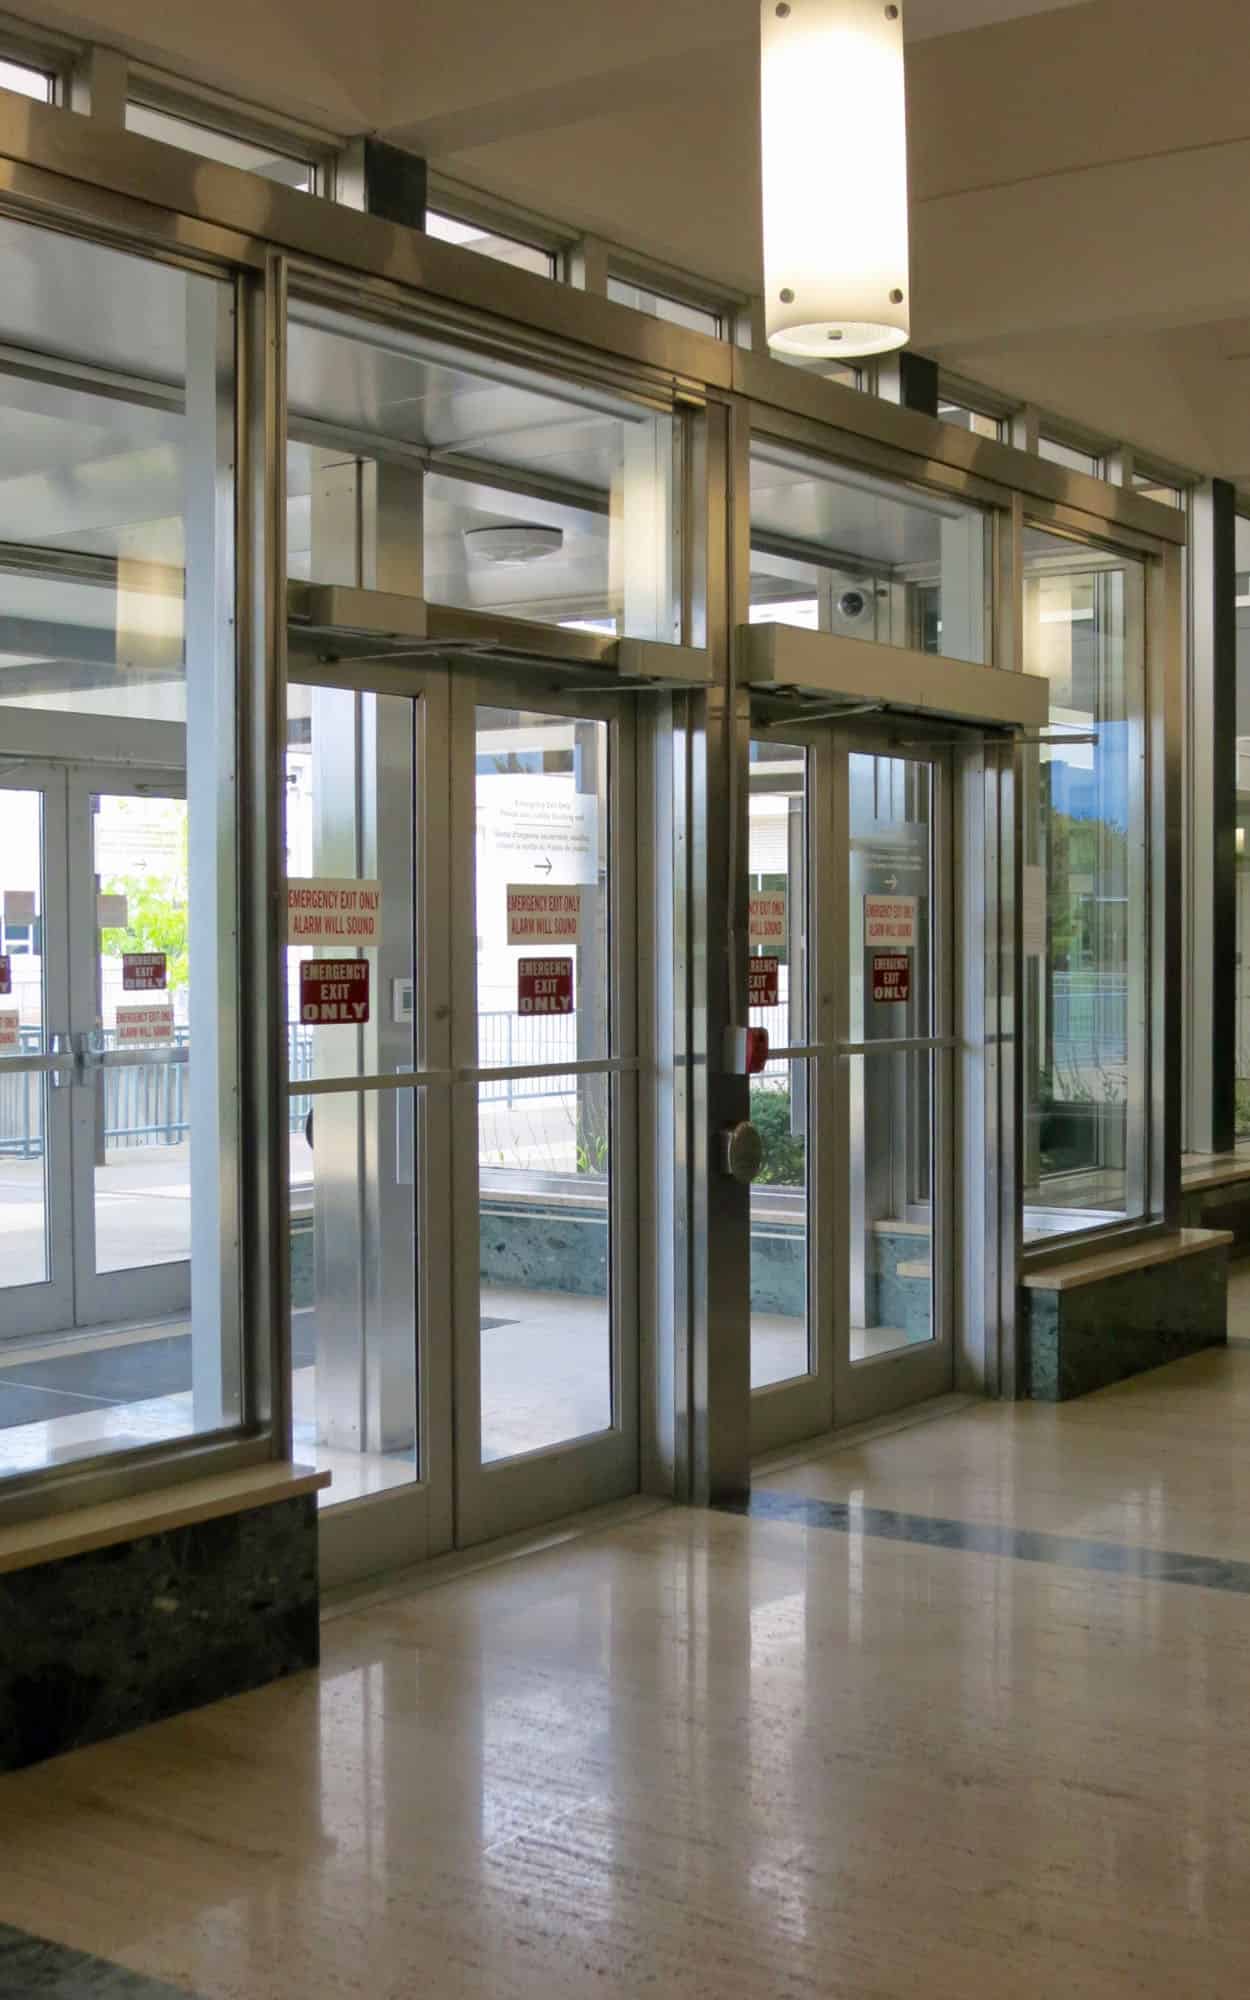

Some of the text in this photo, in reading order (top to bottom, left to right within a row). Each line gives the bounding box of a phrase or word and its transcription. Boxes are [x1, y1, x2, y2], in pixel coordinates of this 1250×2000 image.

[288, 889, 379, 911] EMERGENCY EXIT ONLY
[507, 895, 580, 913] EMERGENCY EXIT ONLY
[293, 914, 375, 936] ALARM WILL SOUND
[511, 917, 577, 935] ALARM WILL SOUND
[135, 966, 154, 977] EXIT
[304, 963, 367, 980] EMERGENCY
[519, 961, 571, 976] EMERGENCY
[874, 958, 908, 971] EMERGENCY
[534, 979, 558, 995] EXIT
[883, 972, 899, 985] EXIT
[320, 983, 351, 1000] EXIT
[748, 990, 777, 1004] NLY
[874, 986, 908, 1000] ONLY
[302, 1002, 367, 1020] ONLY
[520, 996, 571, 1013] ONLY
